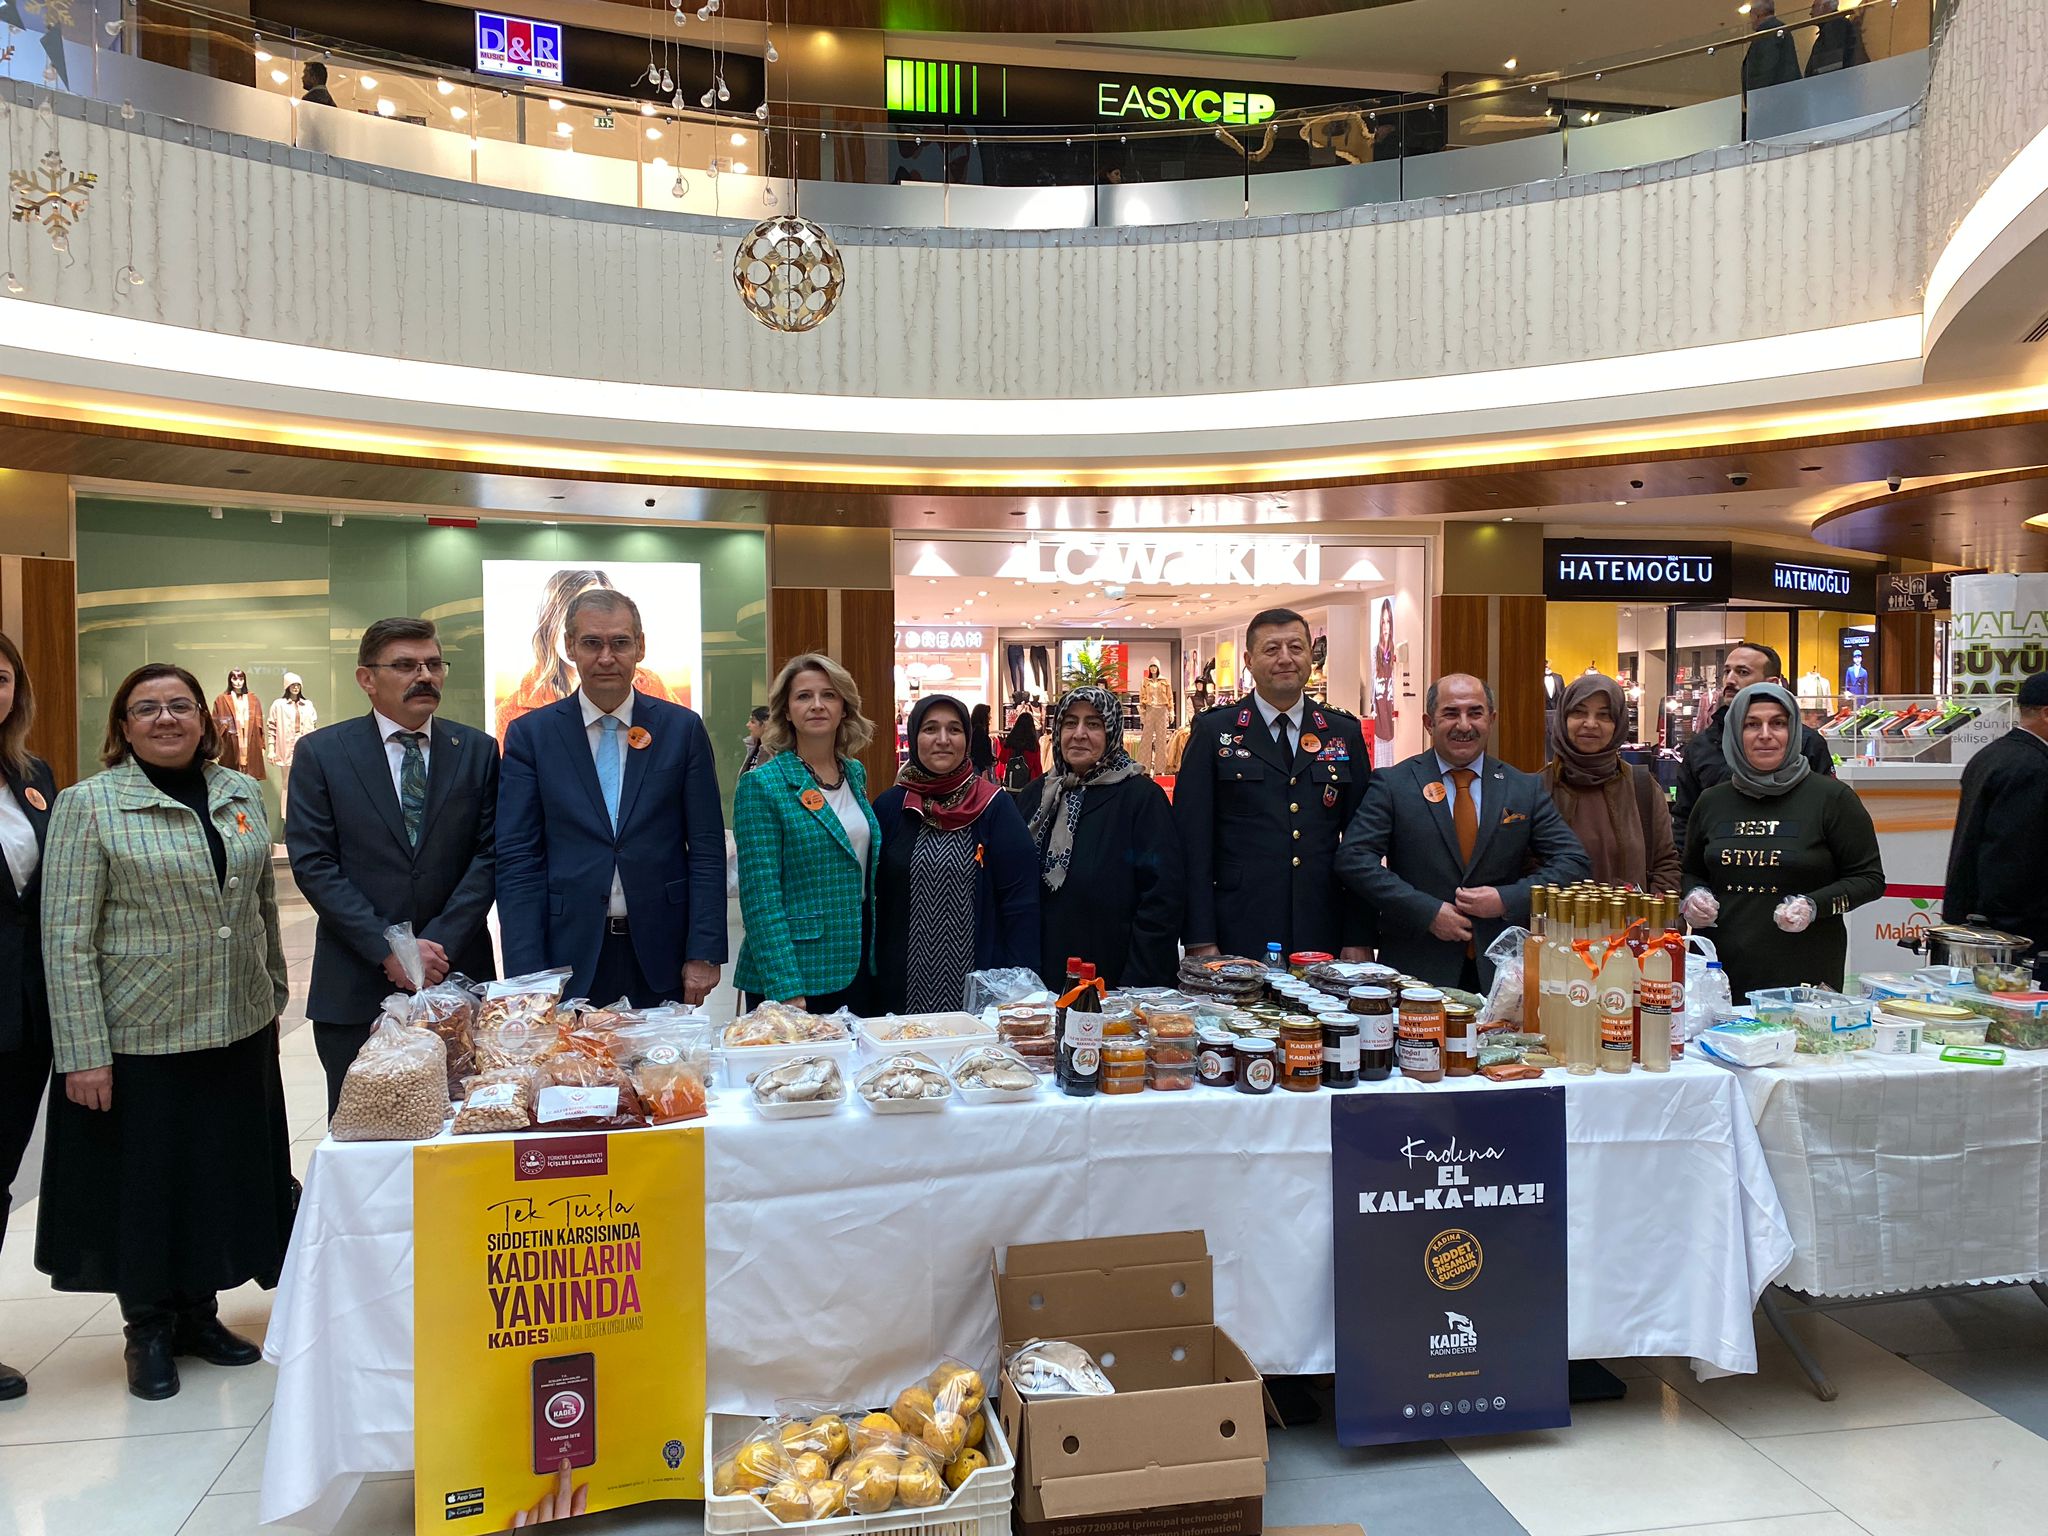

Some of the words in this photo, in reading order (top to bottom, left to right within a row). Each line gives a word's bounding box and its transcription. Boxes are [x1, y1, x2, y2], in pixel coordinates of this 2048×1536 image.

[481, 27, 554, 62] D&R
[481, 51, 505, 61] MUSIC
[534, 59, 558, 70] BOOK
[1098, 83, 1276, 124] EASYCEP
[1952, 611, 2048, 639] MALA
[905, 631, 982, 649] DREAM
[1952, 643, 2048, 676] BÜYÜ
[1733, 820, 1780, 836] BEST
[1720, 849, 1782, 867] STYLE
[1437, 1164, 1470, 1187] EL
[1358, 1182, 1545, 1214] KAL-KA-MAZ!
[486, 1197, 545, 1232] Tek
[548, 1189, 635, 1227] Tuşla
[557, 1222, 641, 1246] KARŞISINDA
[1432, 1233, 1461, 1252] KADINA
[487, 1240, 641, 1286] KADINLARIN
[488, 1273, 642, 1330] YANINDA
[488, 1328, 549, 1349] KADES
[1430, 1333, 1477, 1349] KADES
[1430, 1348, 1451, 1356] KADIN
[1451, 1346, 1477, 1355] DESTEK
[553, 1409, 577, 1418] KADES
[1050, 1520, 1130, 1536] +380677209304
[1132, 1516, 1179, 1530] (principal
[1181, 1509, 1243, 1524] technologist)
